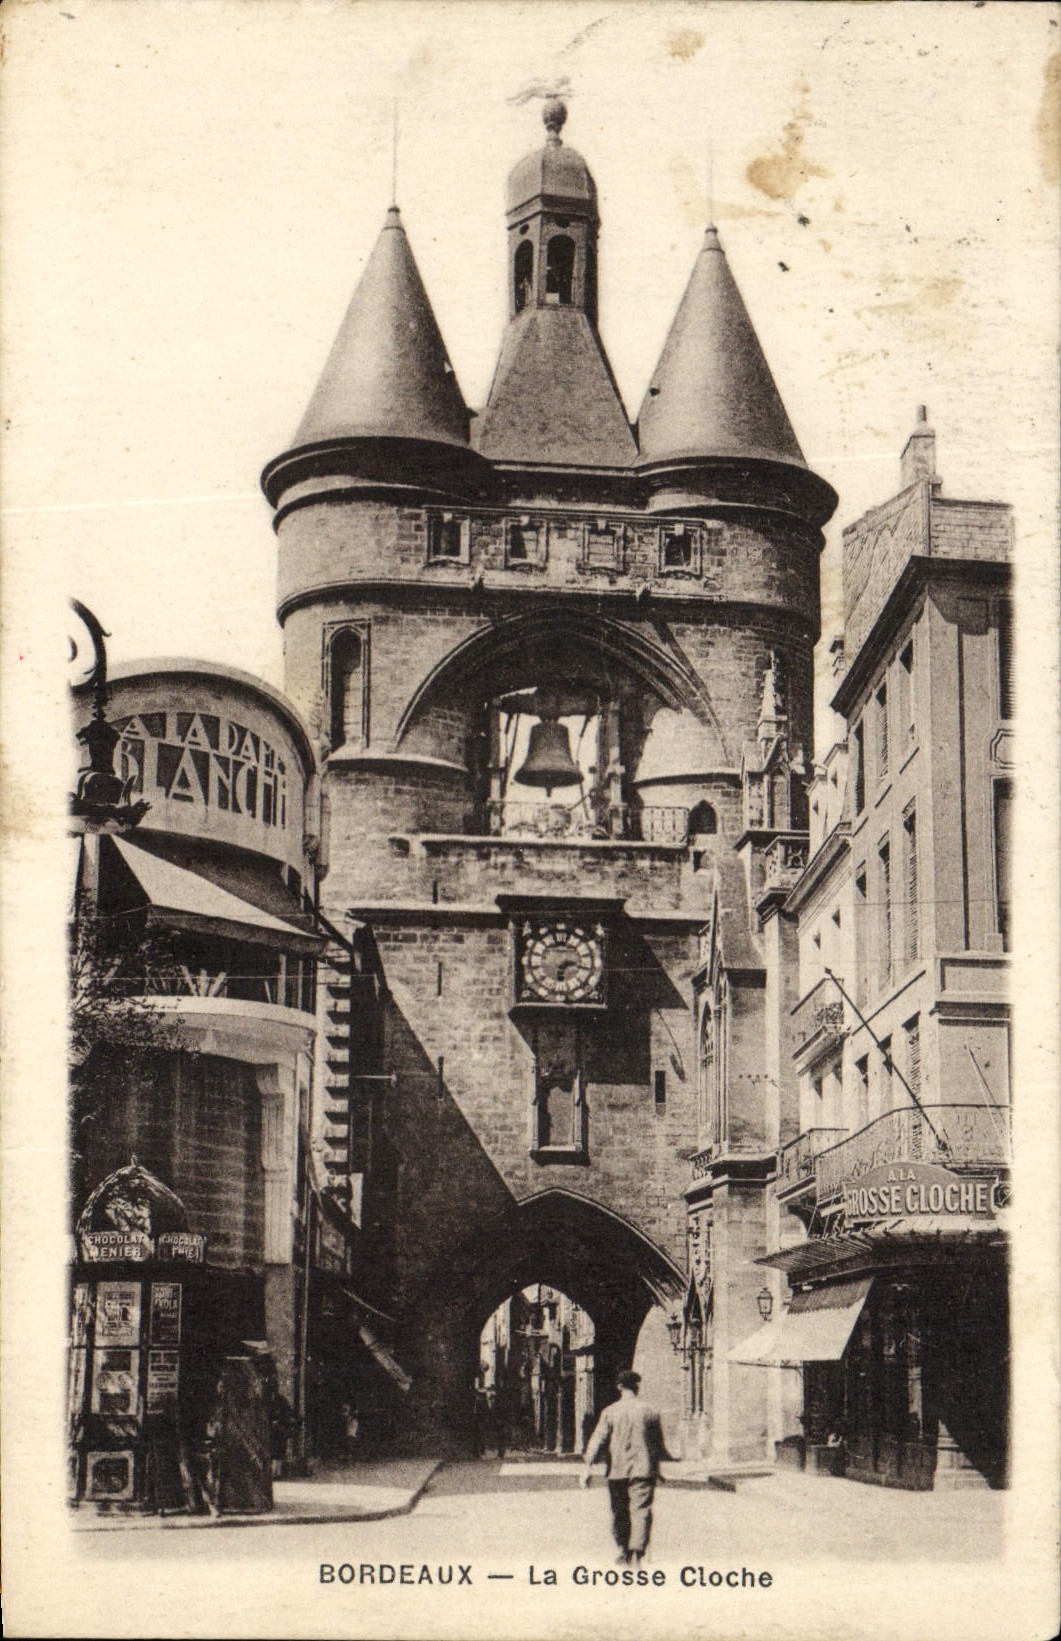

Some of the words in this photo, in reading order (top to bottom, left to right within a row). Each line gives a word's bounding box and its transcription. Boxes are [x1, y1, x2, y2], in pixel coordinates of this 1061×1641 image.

[120, 715, 150, 739] A
[165, 712, 215, 751] LA
[887, 1170, 896, 1183] A
[900, 1168, 916, 1182] LA
[905, 1183, 988, 1213] CLOCHE
[87, 1234, 146, 1245] CHOCOLAT
